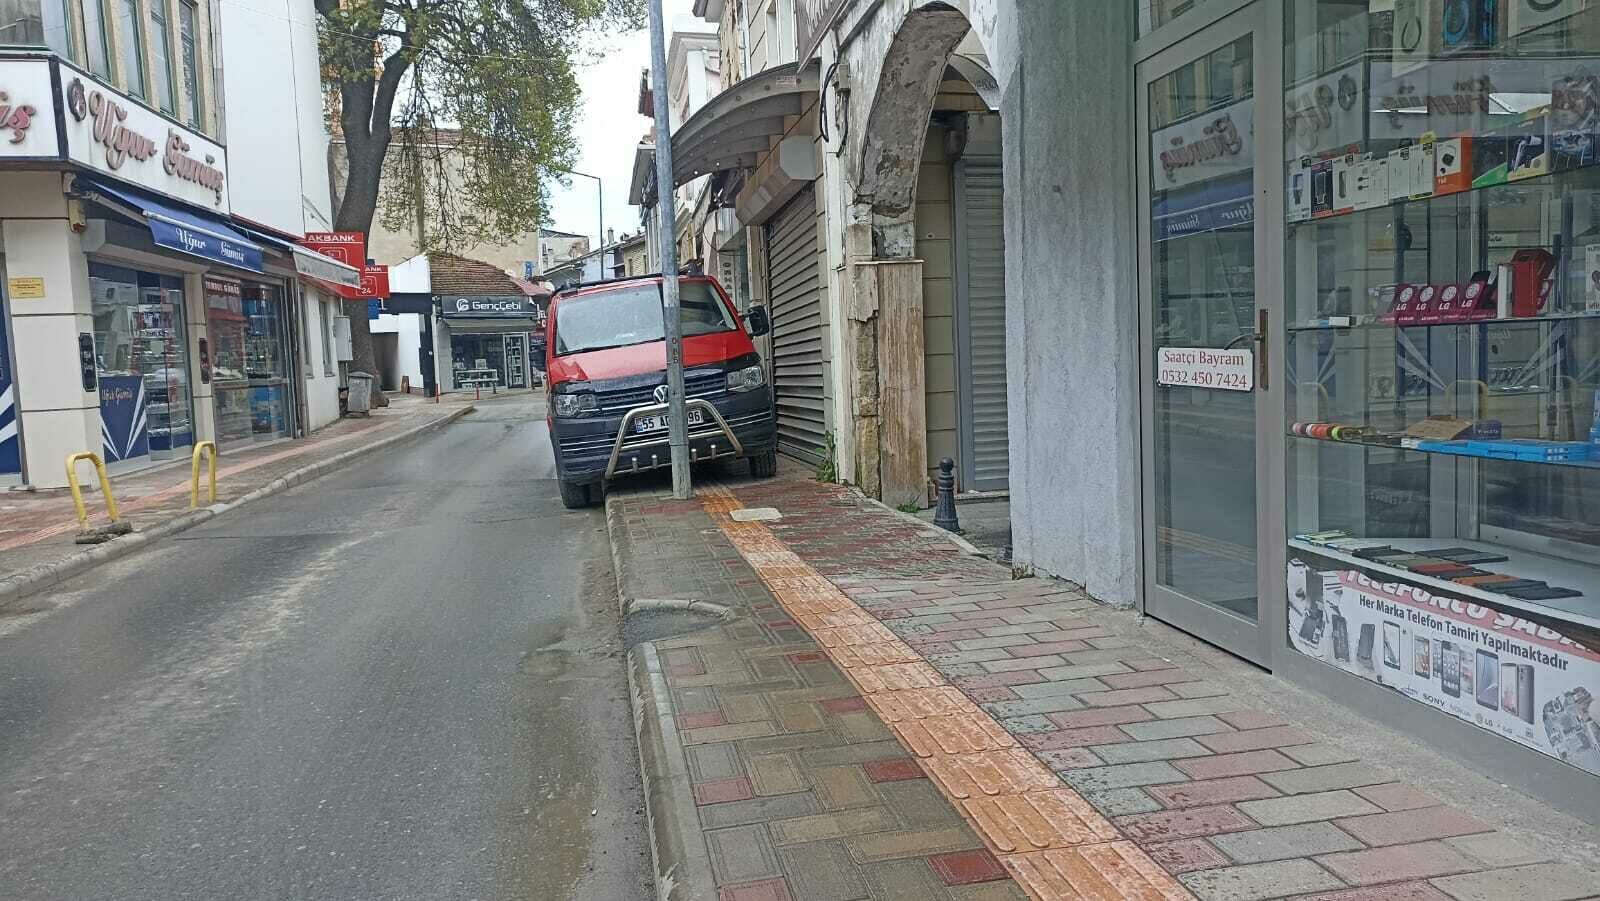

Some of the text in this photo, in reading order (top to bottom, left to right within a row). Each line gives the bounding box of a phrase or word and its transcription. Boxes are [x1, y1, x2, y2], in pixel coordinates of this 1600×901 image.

[89, 90, 224, 206] Uğur Gümüş
[176, 227, 207, 251] Uğur
[308, 234, 355, 242] AKBANK
[1396, 302, 1407, 311] LG
[1416, 302, 1427, 311] LG
[1439, 302, 1450, 310] LG
[1461, 299, 1473, 308] LG
[1164, 350, 1244, 367] Saatçi Bayram
[1162, 369, 1247, 388] 0532 450 7424
[642, 411, 700, 430] 55 A 96
[1360, 594, 1568, 671] Her Marka Telefon Tamiri Yapılmaktadır
[1422, 693, 1445, 707] SONY
